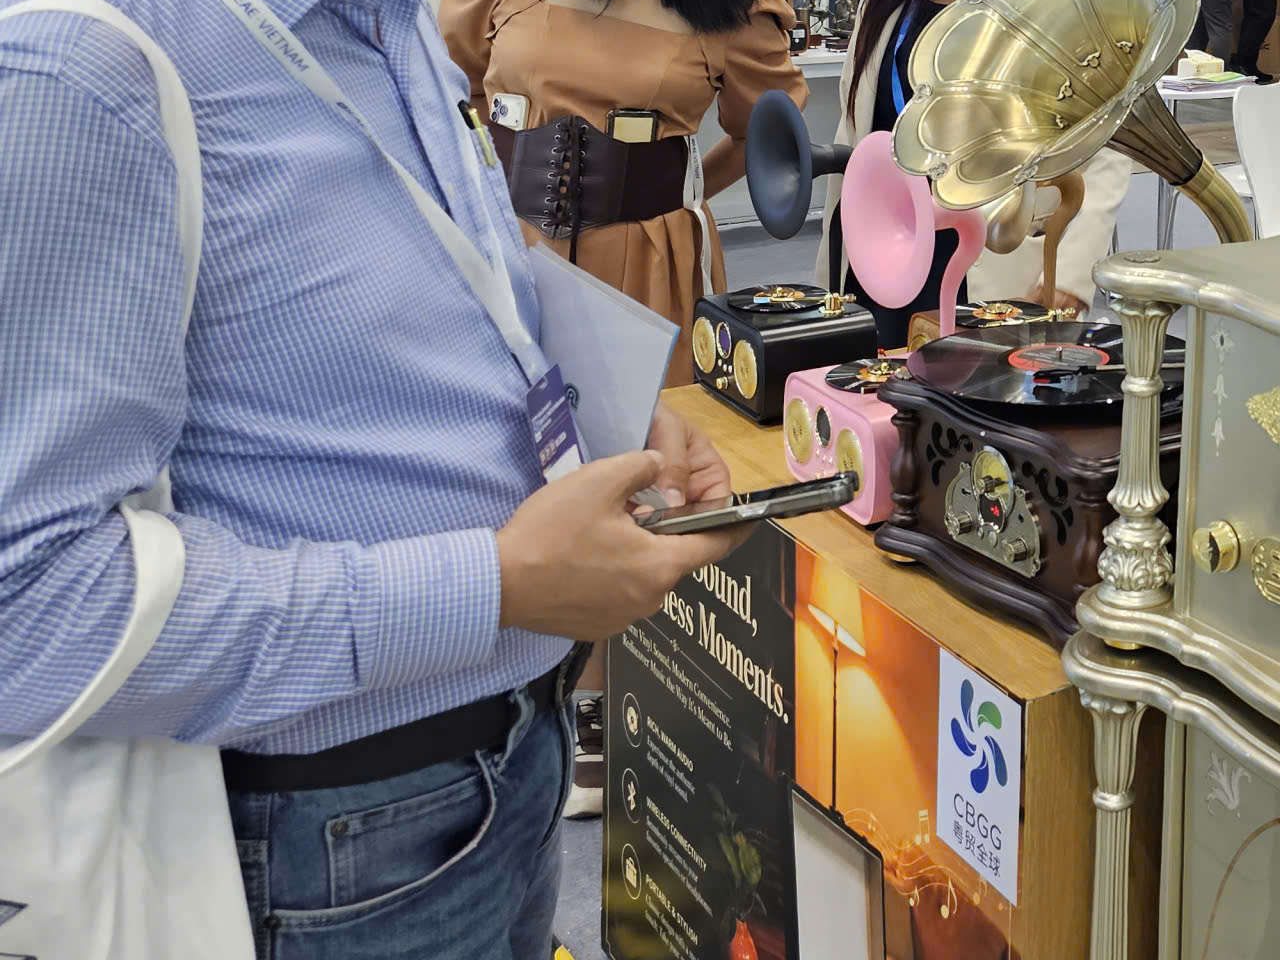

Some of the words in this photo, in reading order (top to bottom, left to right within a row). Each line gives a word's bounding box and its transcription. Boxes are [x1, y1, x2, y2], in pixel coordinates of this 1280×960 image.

[698, 601, 789, 725] Moments.
[676, 748, 694, 772] AUDIO
[953, 793, 1002, 850] CBGG
[670, 824, 707, 873] CONNECTIVITY
[953, 820, 1001, 878] 粤贸全球
[676, 912, 698, 945] STYLISH
